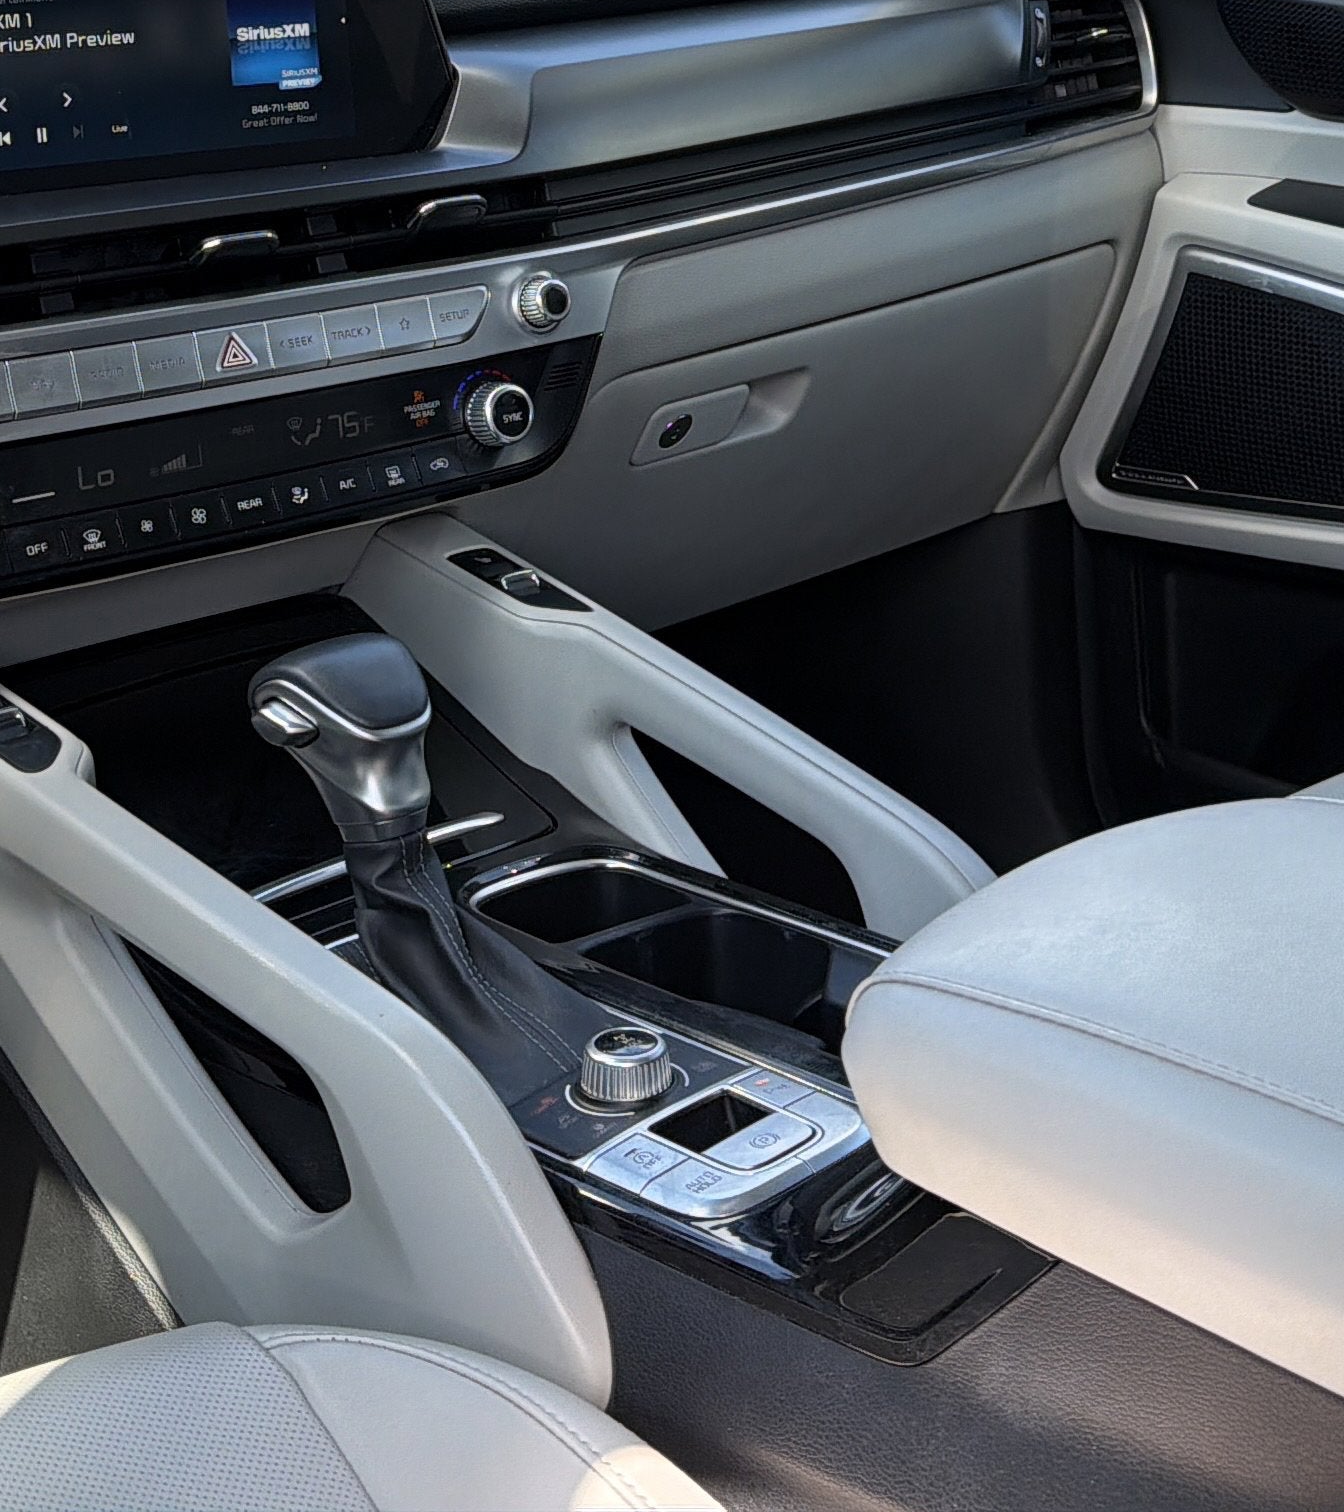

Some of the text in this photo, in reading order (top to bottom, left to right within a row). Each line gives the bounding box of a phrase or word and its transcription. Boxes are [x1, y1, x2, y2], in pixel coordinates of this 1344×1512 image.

[25, 12, 33, 28] 1
[66, 29, 135, 49] Preview
[236, 22, 310, 42] SiriusXM
[439, 308, 470, 323] SETUP
[331, 328, 364, 341] TRACK
[288, 335, 313, 349] SEEK
[502, 411, 524, 424] SYNC
[338, 476, 357, 490] A/C
[236, 497, 264, 511] REAR
[26, 541, 49, 557] OFF
